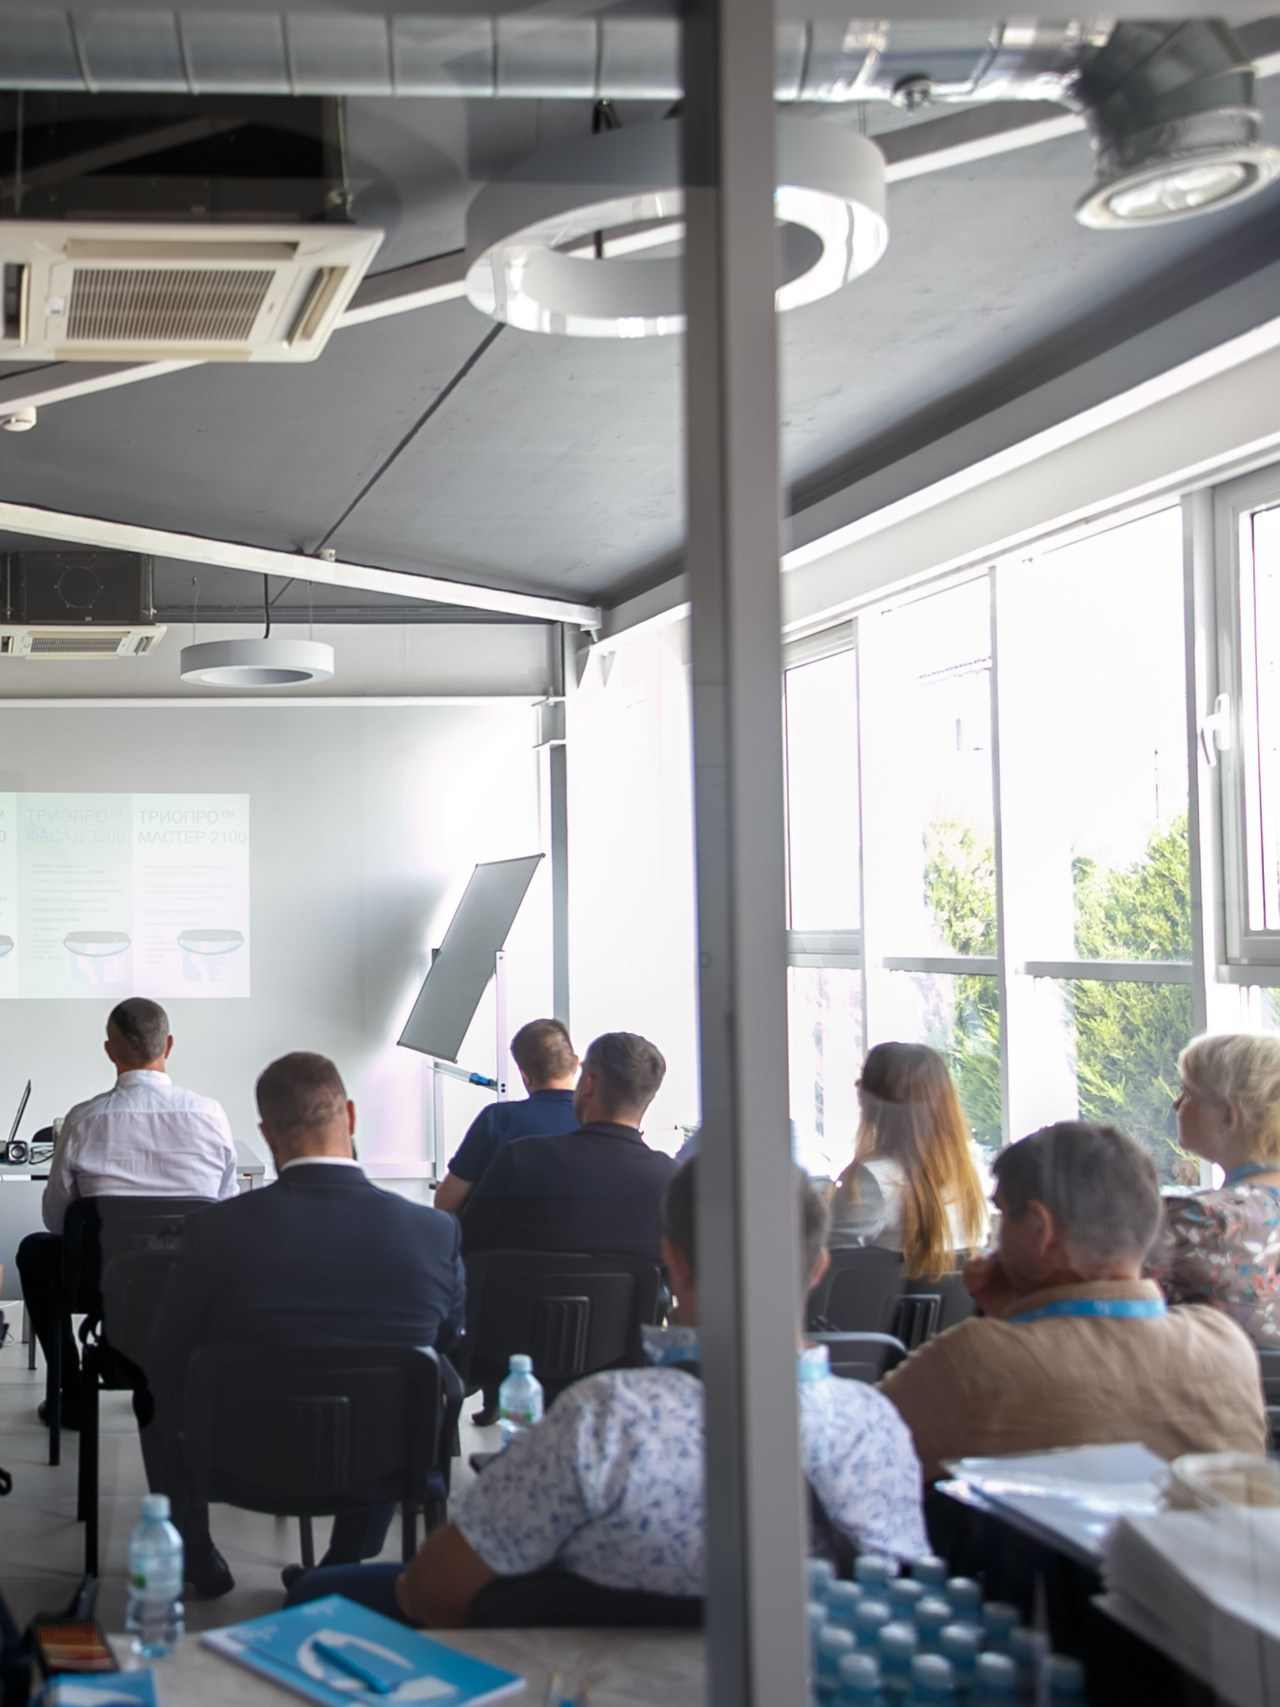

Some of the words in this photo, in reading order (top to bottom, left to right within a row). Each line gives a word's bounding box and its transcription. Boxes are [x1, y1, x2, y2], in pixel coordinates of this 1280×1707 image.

[26, 829, 83, 845] ФАСАД
[89, 830, 126, 843] 3200
[138, 830, 206, 844] МАСТЕР
[210, 830, 247, 844] 2100
